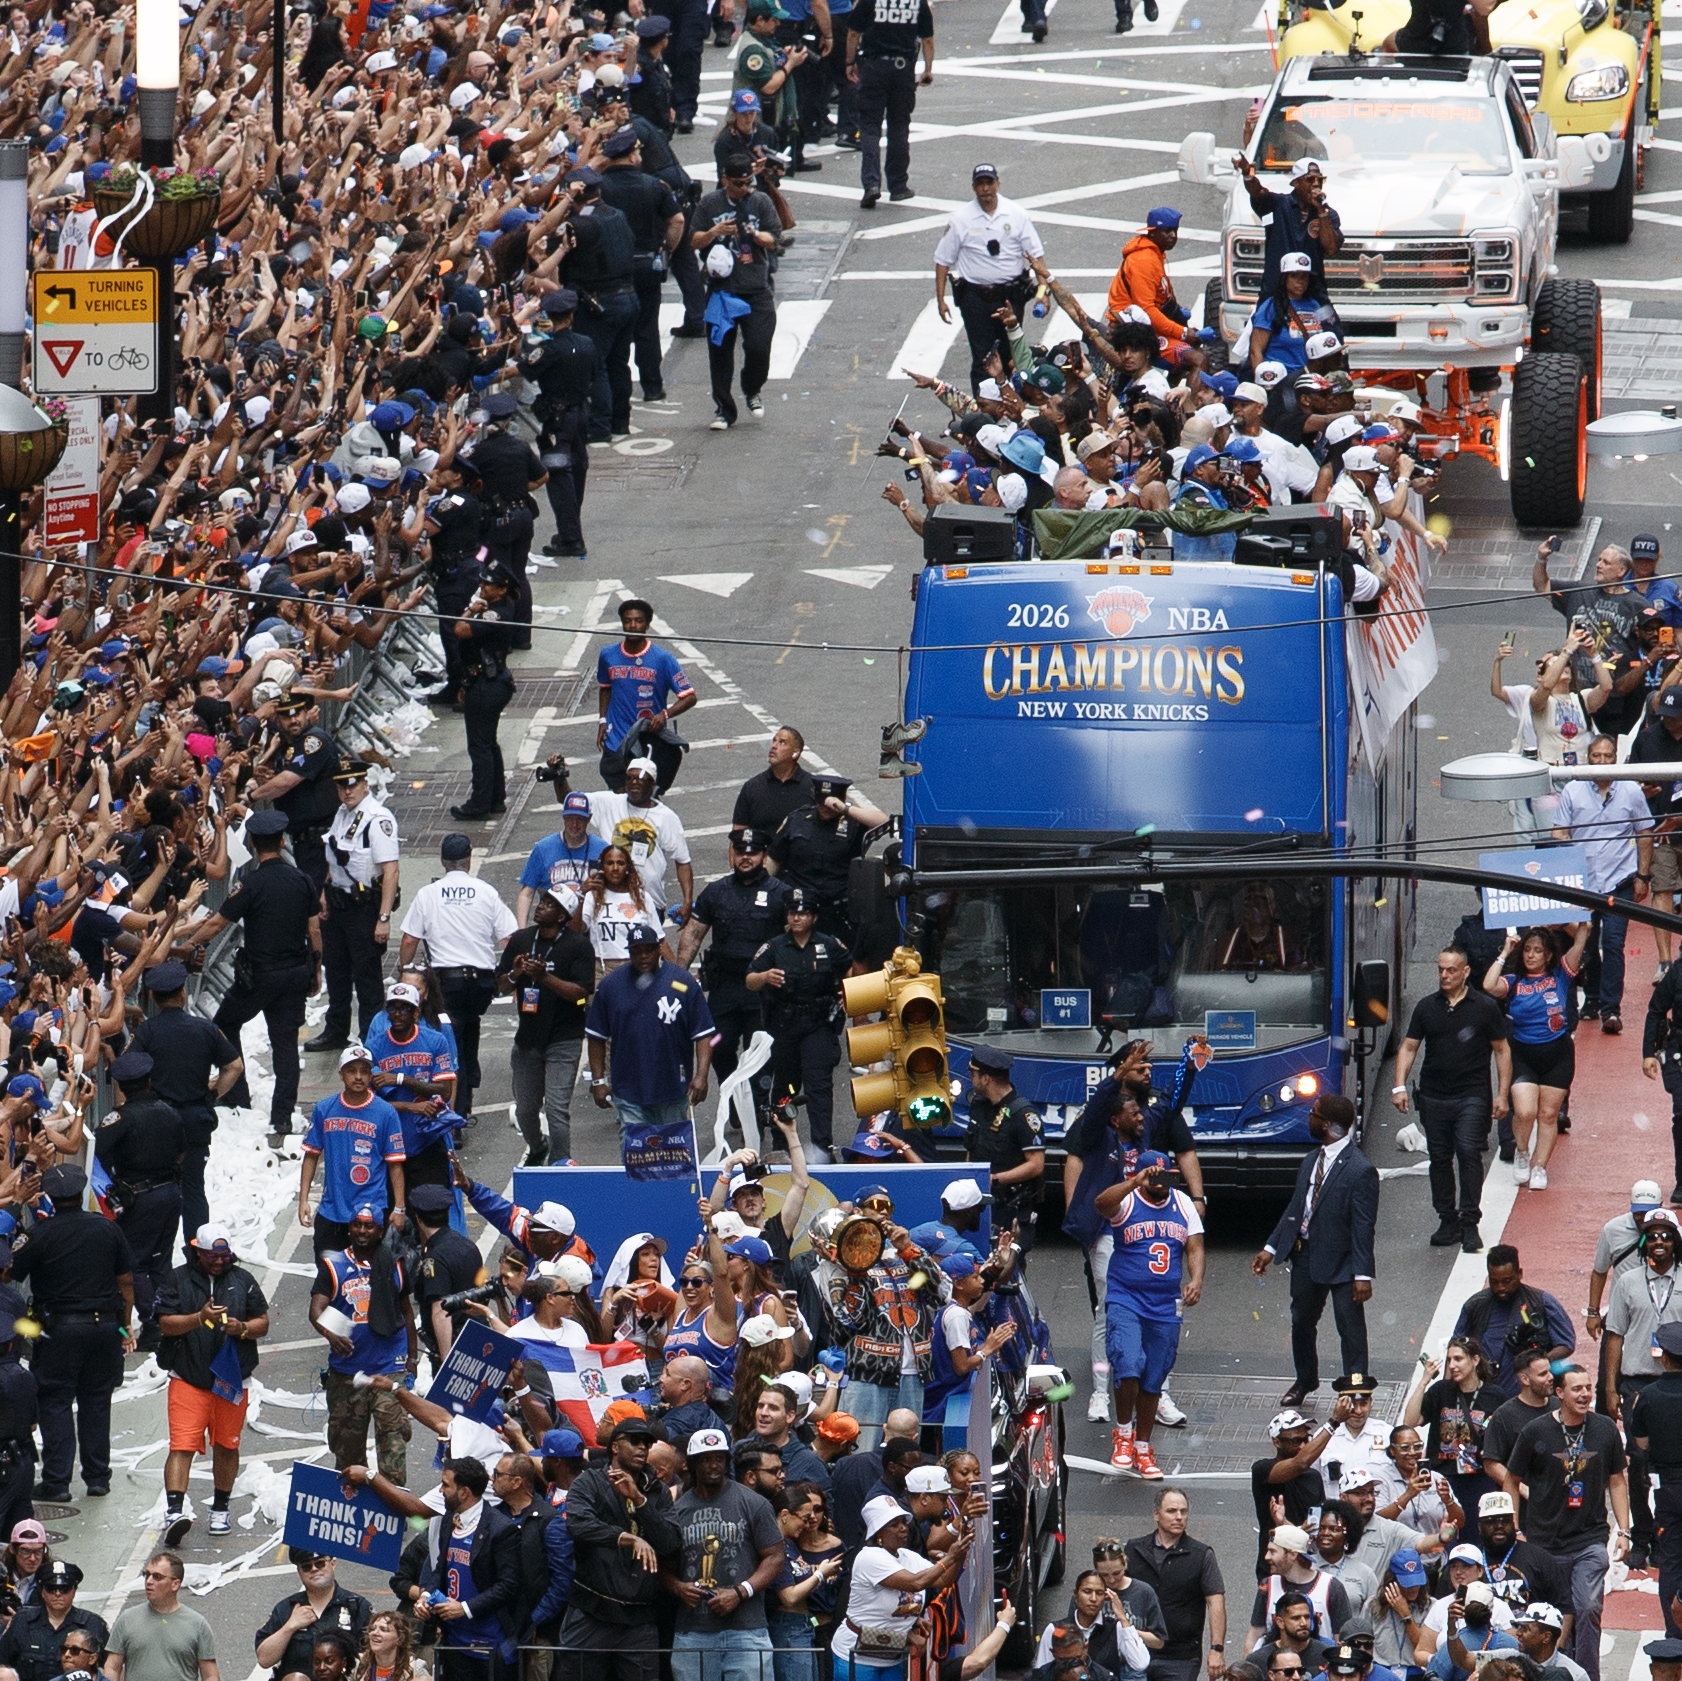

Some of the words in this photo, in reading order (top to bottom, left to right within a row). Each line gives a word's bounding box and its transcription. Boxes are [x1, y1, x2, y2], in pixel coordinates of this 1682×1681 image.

[874, 9, 918, 24] DCPI
[88, 280, 144, 294] TURNING
[85, 299, 148, 313] VEHICLES
[84, 353, 103, 366] TO
[48, 500, 57, 511] NO
[58, 499, 89, 510] STOPPING
[48, 511, 75, 524] Anytime
[1634, 541, 1656, 550] NYPD
[1007, 603, 1070, 628] 2026
[1168, 607, 1229, 631] NBA
[983, 643, 1245, 705] CHAMPIONS
[1017, 700, 1069, 720] NEW
[1073, 701, 1128, 720] YORK
[1132, 702, 1209, 722] KNICKS
[441, 886, 476, 899] NYPD
[1054, 996, 1077, 1007] BUS
[1060, 1008, 1071, 1018] #1
[379, 1056, 404, 1073] NEW
[405, 1052, 433, 1067] YORK
[348, 1119, 376, 1138] YORK
[668, 1136, 686, 1145] NBA
[1124, 1221, 1155, 1244] NEW
[1148, 1243, 1171, 1275] 3
[447, 1350, 482, 1380] THANK
[482, 1364, 507, 1389] YOU
[444, 1374, 480, 1403] FANS!
[295, 1492, 359, 1526] THANK
[362, 1509, 399, 1535] YOU
[695, 1509, 727, 1526] NBA
[308, 1517, 362, 1548] FANS!
[448, 1568, 460, 1601] 3
